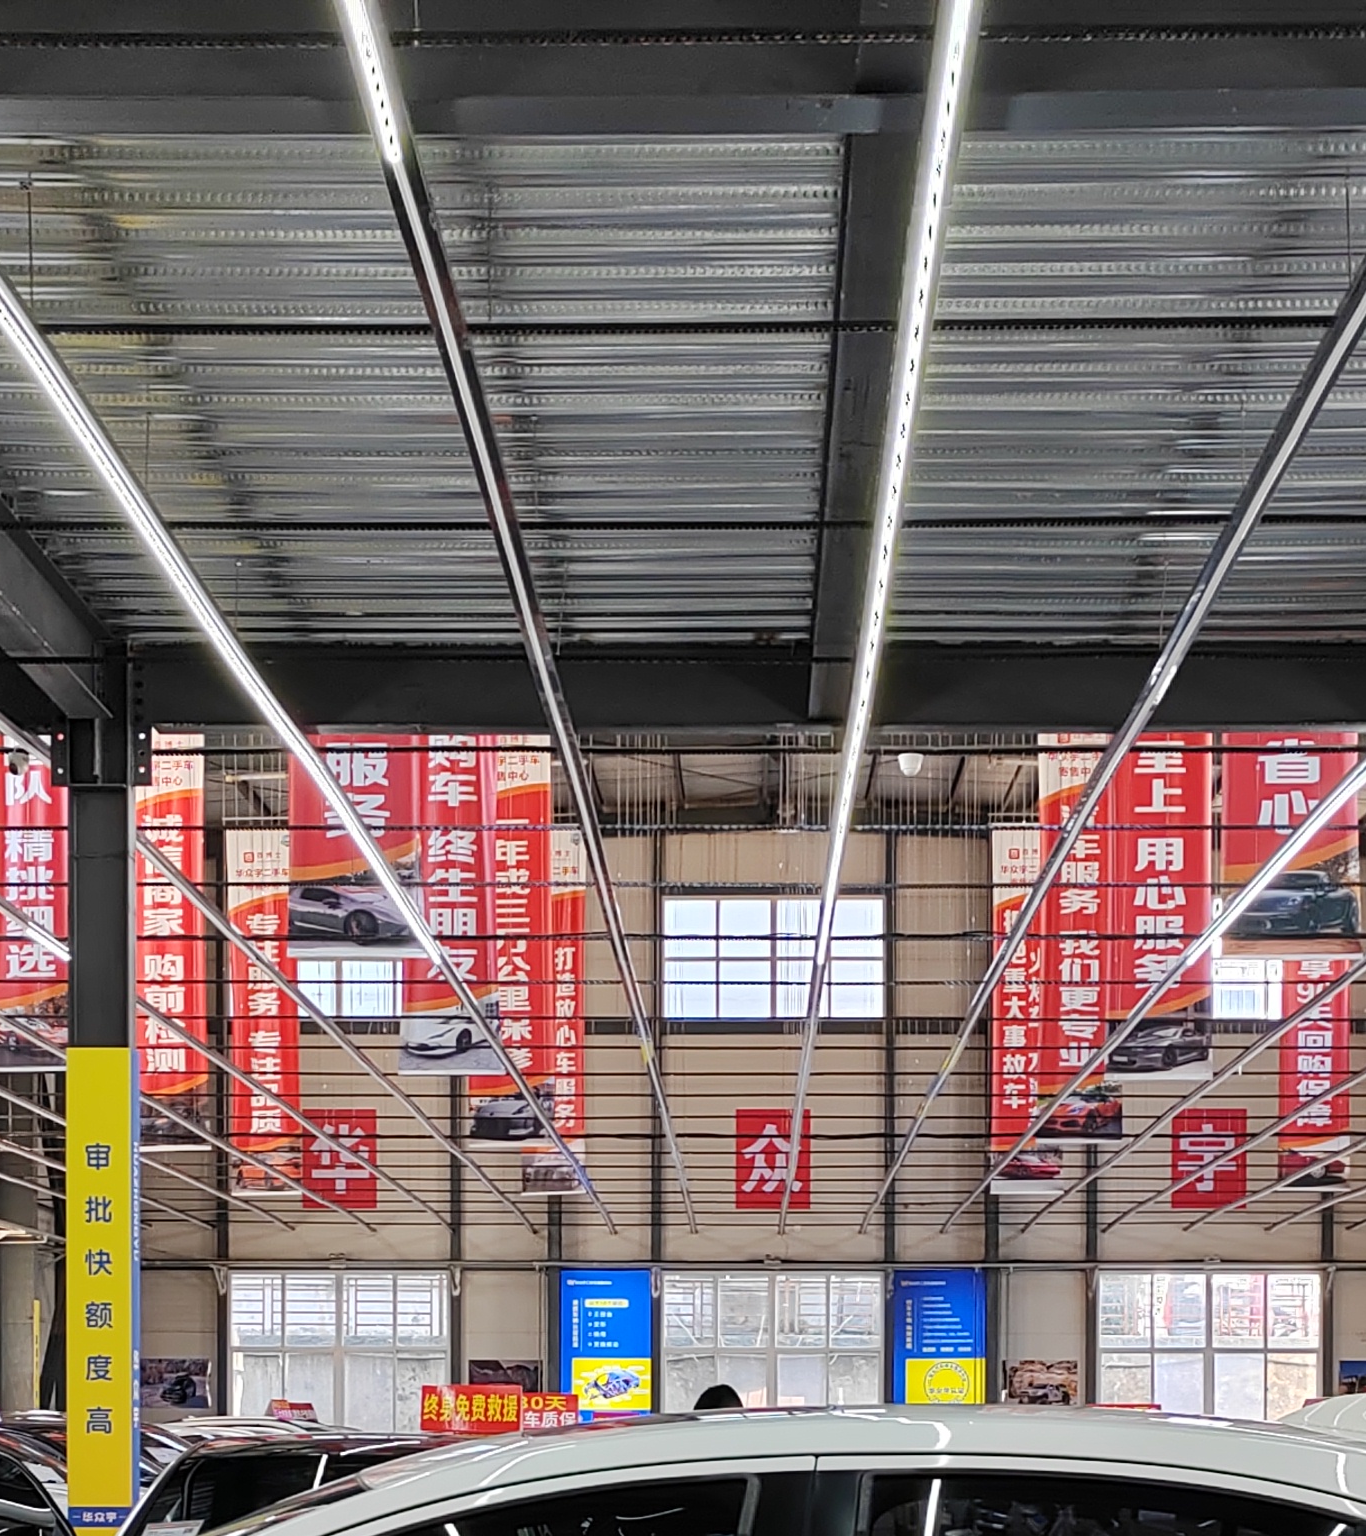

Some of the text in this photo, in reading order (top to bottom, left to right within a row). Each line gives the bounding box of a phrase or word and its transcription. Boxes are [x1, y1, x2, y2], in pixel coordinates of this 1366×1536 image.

[324, 742, 391, 838] 服务
[428, 735, 477, 807] 购车
[1134, 741, 1187, 813] 至上
[1257, 738, 1322, 836] 省心
[4, 830, 57, 979] 精挑细选
[141, 814, 184, 937] 诚信商家
[428, 828, 478, 981] 终生朋友
[1133, 838, 1187, 991] 用心服务
[143, 954, 185, 1074] 购前检测
[246, 913, 282, 1016] 专注服务
[1059, 930, 1101, 1067] 我们更专业
[248, 1031, 282, 1134] 专注品质
[554, 946, 578, 1129] 打造放心车服务
[309, 1122, 1238, 1195] 华 众 宇
[84, 1142, 114, 1435] 审批快额度高
[423, 1393, 518, 1423] 终身免费救援
